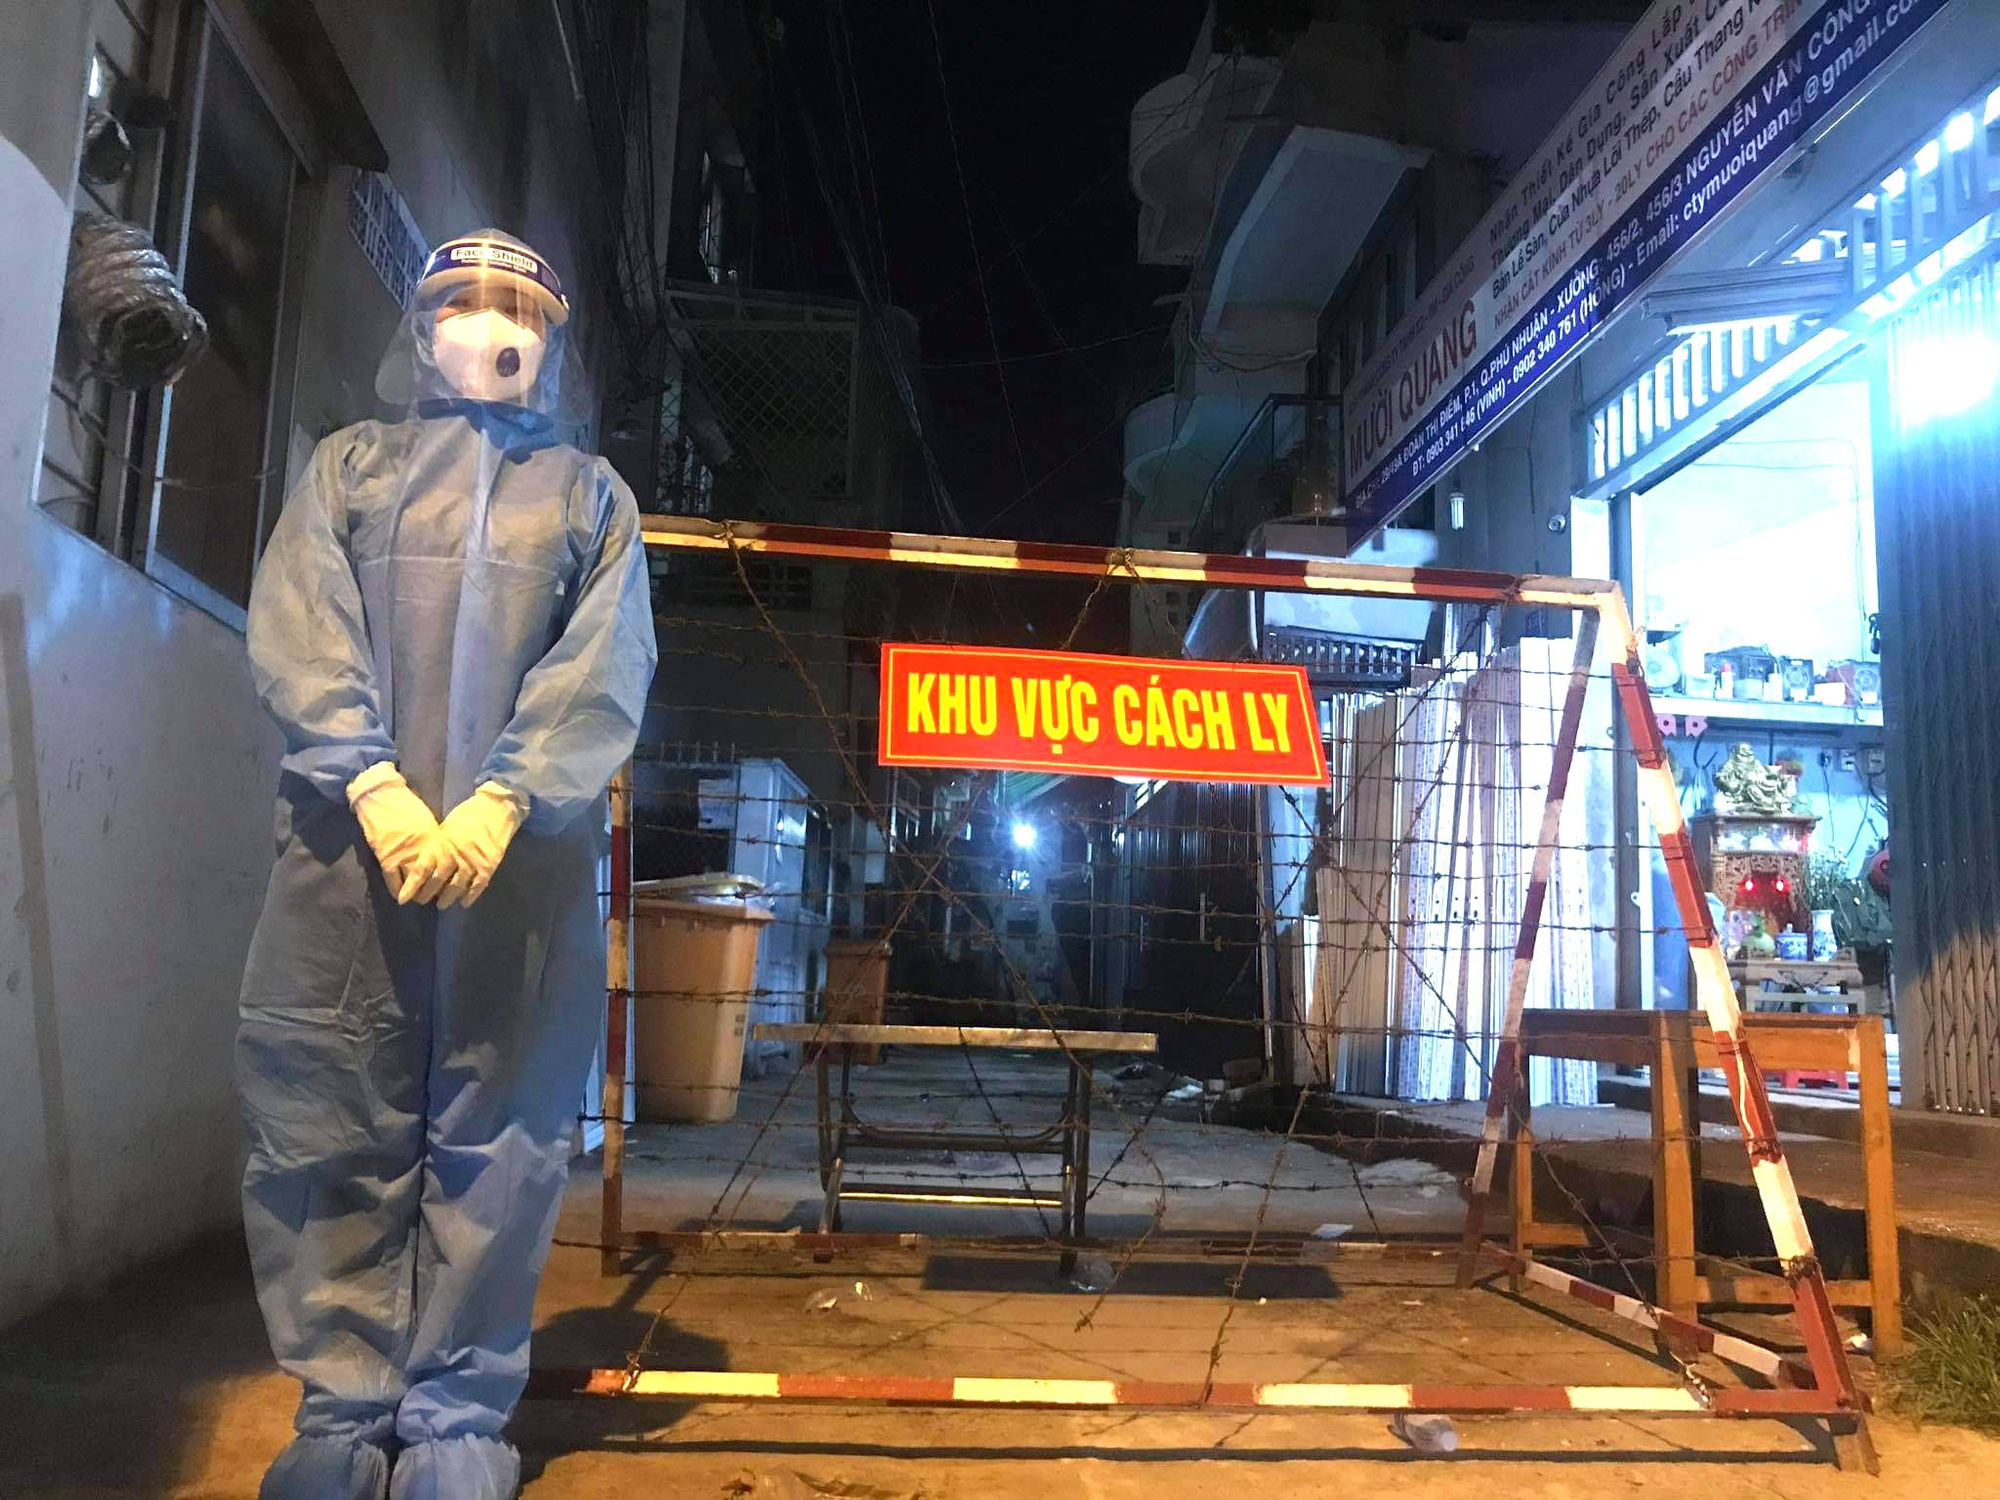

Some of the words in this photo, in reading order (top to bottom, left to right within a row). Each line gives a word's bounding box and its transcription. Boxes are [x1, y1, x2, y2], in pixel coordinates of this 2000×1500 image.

[1521, 158, 1552, 204] Thiết
[1555, 131, 1573, 165] Kế
[1577, 104, 1600, 138] Gia
[1605, 47, 1645, 105] Công
[1559, 157, 1582, 193] Dân
[1663, 13, 1700, 72] Xuất
[1614, 159, 1642, 202] 20LY
[1645, 123, 1674, 169] CHO
[1678, 87, 1707, 135] CÁC
[1712, 32, 1758, 98] CÔNG
[1624, 106, 1661, 150] Thép,
[1663, 65, 1692, 109] Cầu
[1693, 6, 1743, 70] Thang
[456, 248, 487, 257] Fac
[492, 248, 533, 269] Shield
[1412, 457, 1425, 477] ĐT:
[1426, 436, 1444, 464] 0903
[1445, 422, 1458, 447] 341
[1476, 377, 1506, 420] (VINH)
[1512, 349, 1536, 384] 0902
[1537, 330, 1557, 360] 340
[1557, 309, 1577, 340] 761
[1636, 213, 1680, 266] Email:
[1683, 0, 1918, 220] ctymuoiquang@gmail.co
[1464, 380, 1479, 403] P.1,
[1480, 341, 1510, 387] Q.PHÚ
[1512, 307, 1548, 357] NHUẬN
[1607, 217, 1643, 262] 456/2,
[1646, 173, 1683, 222] 456/3
[1685, 95, 1758, 185] NGUYỄN
[1762, 49, 1803, 105] VĂN
[1350, 387, 1393, 477] MƯỜI
[1399, 300, 1477, 422] QUANG
[907, 672, 997, 737] KHU
[1011, 674, 1100, 754] VỰC
[1113, 675, 1236, 751] CÁCH
[1243, 691, 1292, 753] LY
